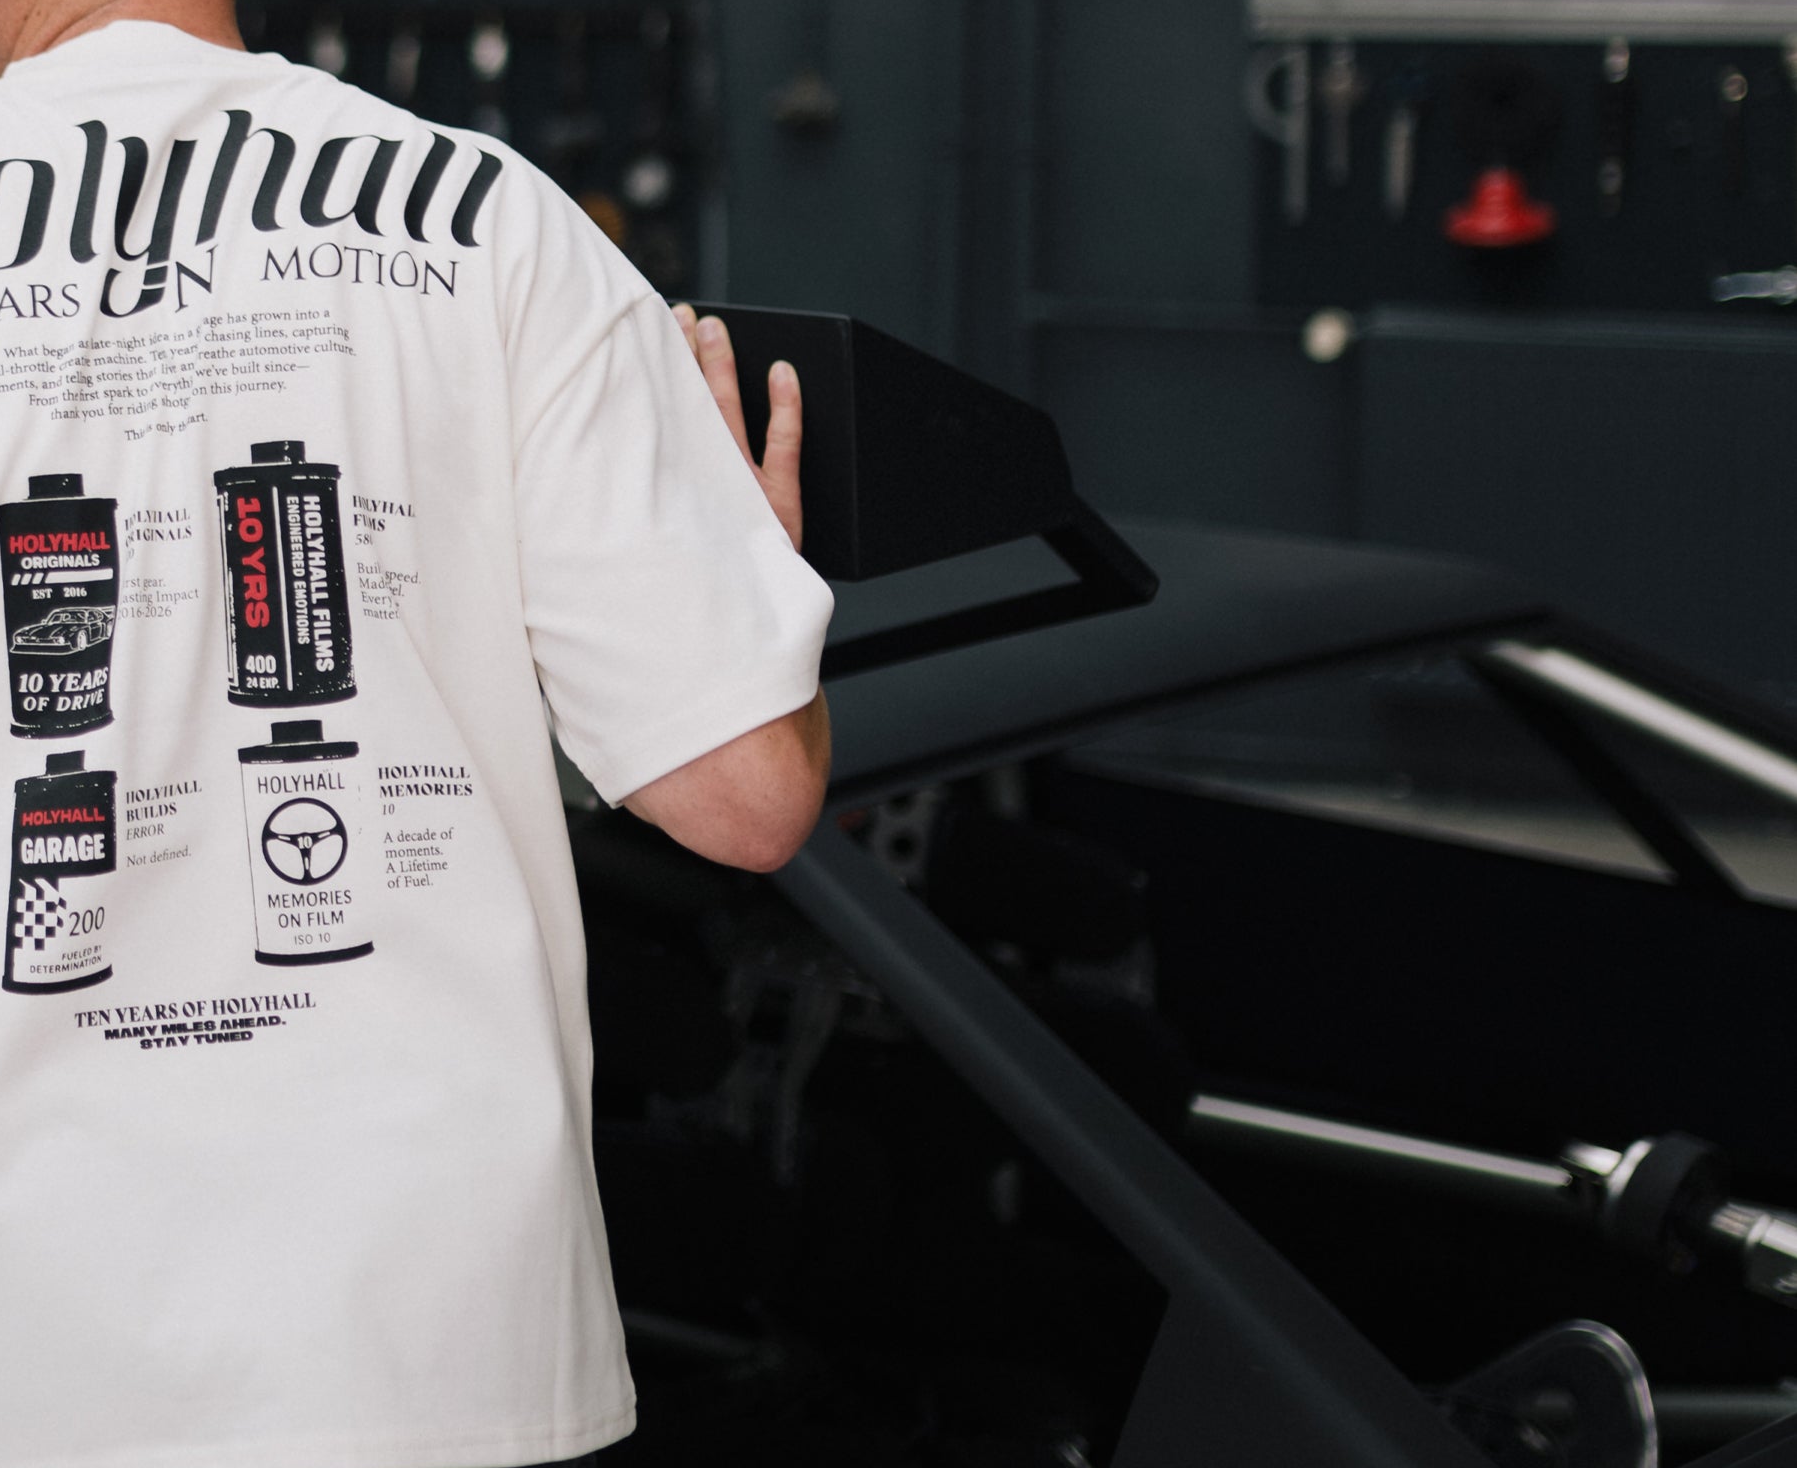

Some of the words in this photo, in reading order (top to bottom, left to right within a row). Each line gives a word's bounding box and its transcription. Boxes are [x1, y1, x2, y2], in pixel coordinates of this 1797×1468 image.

[261, 242, 460, 298] MOTION
[3, 346, 38, 358] What
[90, 335, 146, 352] late-night
[173, 333, 185, 341] in
[227, 312, 247, 323] has
[251, 311, 291, 325] grown
[295, 308, 320, 321] into
[323, 309, 330, 318] a
[94, 353, 147, 366] machine.
[204, 329, 252, 343] chasing
[255, 326, 288, 339] lines,
[292, 323, 350, 341] capturing
[41, 376, 62, 390] and
[96, 370, 133, 382] stories
[198, 346, 236, 360] reathe
[239, 343, 311, 357] automotive
[29, 394, 59, 407] From
[103, 386, 135, 402] spark
[136, 388, 148, 398] to
[195, 364, 228, 378] we've
[232, 361, 261, 374] built
[51, 408, 80, 421] thank
[81, 407, 105, 423] you
[108, 402, 124, 416] for
[192, 385, 207, 397] on
[210, 381, 232, 395] this
[235, 380, 288, 397] journey.
[237, 497, 264, 543] 10
[9, 531, 111, 554] HOLYHALL
[286, 495, 306, 577] ENGINEERED
[303, 495, 329, 604] HOLYHALL
[21, 553, 100, 570] ORIGINALS
[32, 588, 52, 600] EST
[63, 586, 88, 599] 2016
[143, 578, 167, 591] gear.
[242, 547, 270, 628] YRS
[122, 591, 153, 607] asting
[156, 588, 199, 605] Impact
[293, 581, 311, 645] EMOTIONS
[313, 608, 335, 672] FILMS
[245, 654, 277, 674] 400
[18, 672, 44, 694] 10
[48, 666, 109, 693] YEARS
[246, 677, 259, 689] 24
[260, 677, 280, 689] EXP.
[23, 696, 50, 712] OF
[56, 688, 105, 712] DRIVE
[378, 764, 470, 780] HOLYHALL
[126, 780, 202, 804] HOLYHALL
[257, 772, 345, 794] HOLYHALL
[379, 782, 473, 798] MEMORIES
[22, 807, 105, 826] HOLYHALL
[126, 802, 177, 822] BUILDS
[382, 803, 395, 815] 10
[126, 823, 164, 840] ERROR
[383, 832, 394, 844] A
[397, 830, 437, 842] decade
[440, 827, 454, 840] of
[21, 833, 106, 865] GARAGE
[297, 835, 313, 850] 10
[385, 846, 444, 858] moments.
[126, 855, 146, 868] Not
[150, 845, 192, 863] defined.
[386, 861, 395, 873] A
[400, 859, 448, 873] Lifetime
[387, 876, 401, 889] of
[404, 875, 434, 888] Fuel.
[268, 889, 352, 908] MEMORIES
[69, 906, 105, 937] 200
[278, 913, 301, 928] ON
[307, 910, 344, 927] FILM
[294, 934, 313, 945] ISO
[319, 932, 331, 943] 10
[61, 946, 92, 961] FUELED
[29, 955, 102, 974] DETERMINATION
[75, 1010, 111, 1028] TEN
[114, 1003, 179, 1023] YEARS
[182, 1000, 207, 1018] OF
[212, 992, 317, 1016] HOLYHALL
[104, 1025, 159, 1040] MANY
[161, 1020, 216, 1036] MILES
[219, 1015, 287, 1031] AHEAD.
[140, 1035, 191, 1050] STAY
[196, 1031, 254, 1045] TUNED
